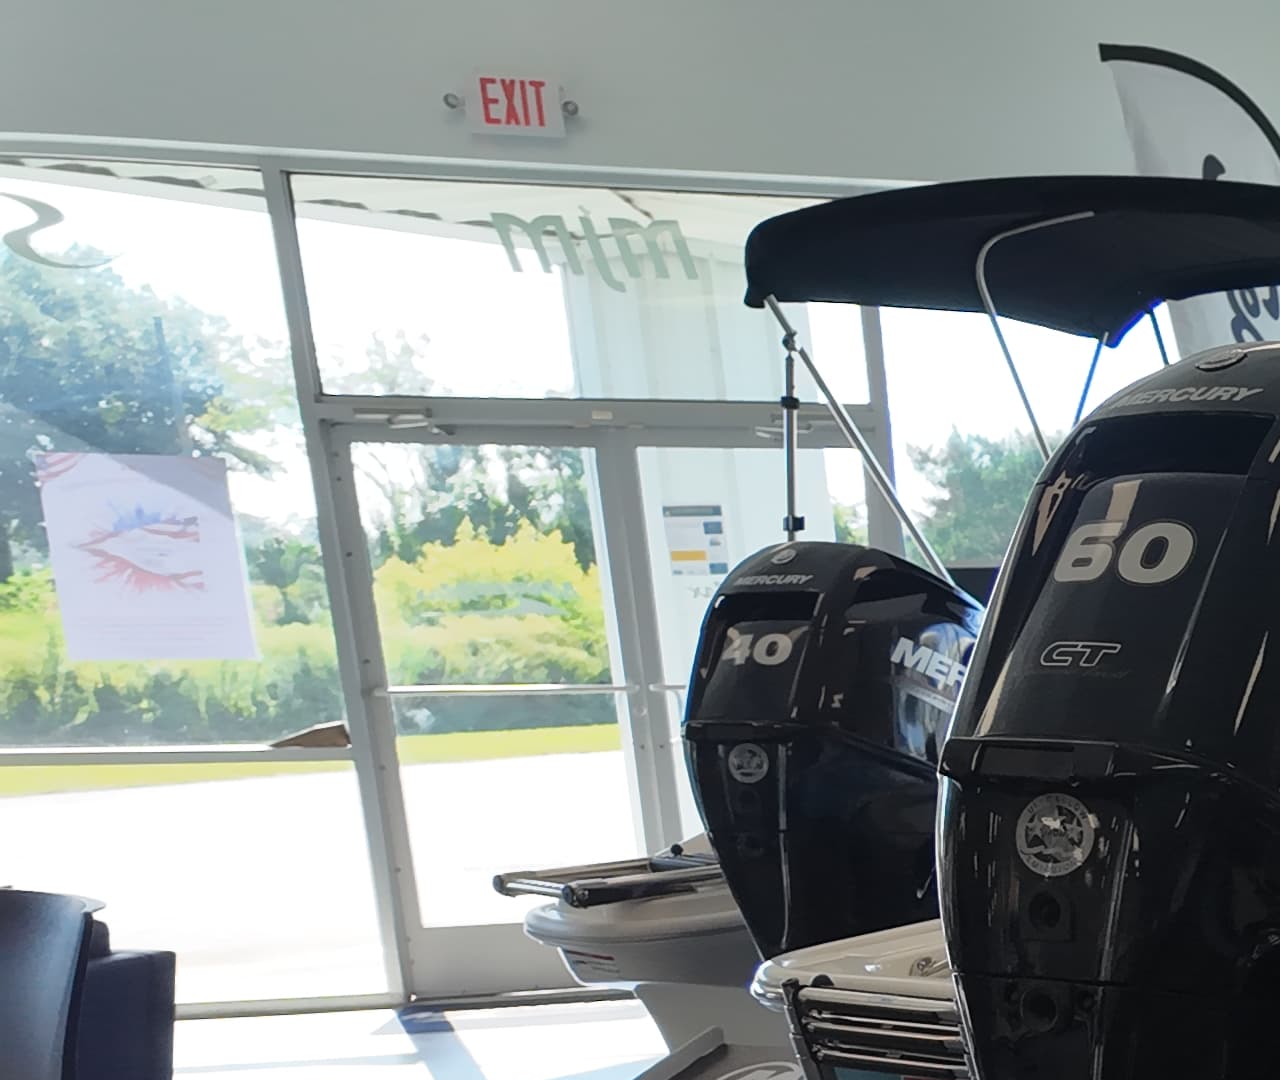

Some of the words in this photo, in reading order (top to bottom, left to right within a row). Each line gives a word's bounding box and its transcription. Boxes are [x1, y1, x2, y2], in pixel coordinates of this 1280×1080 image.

[479, 77, 546, 127] EXIT
[1053, 519, 1196, 584] 60
[733, 574, 813, 587] MERCURY
[722, 633, 793, 666] 40
[891, 636, 968, 691] MER
[1040, 641, 1122, 667] CT
